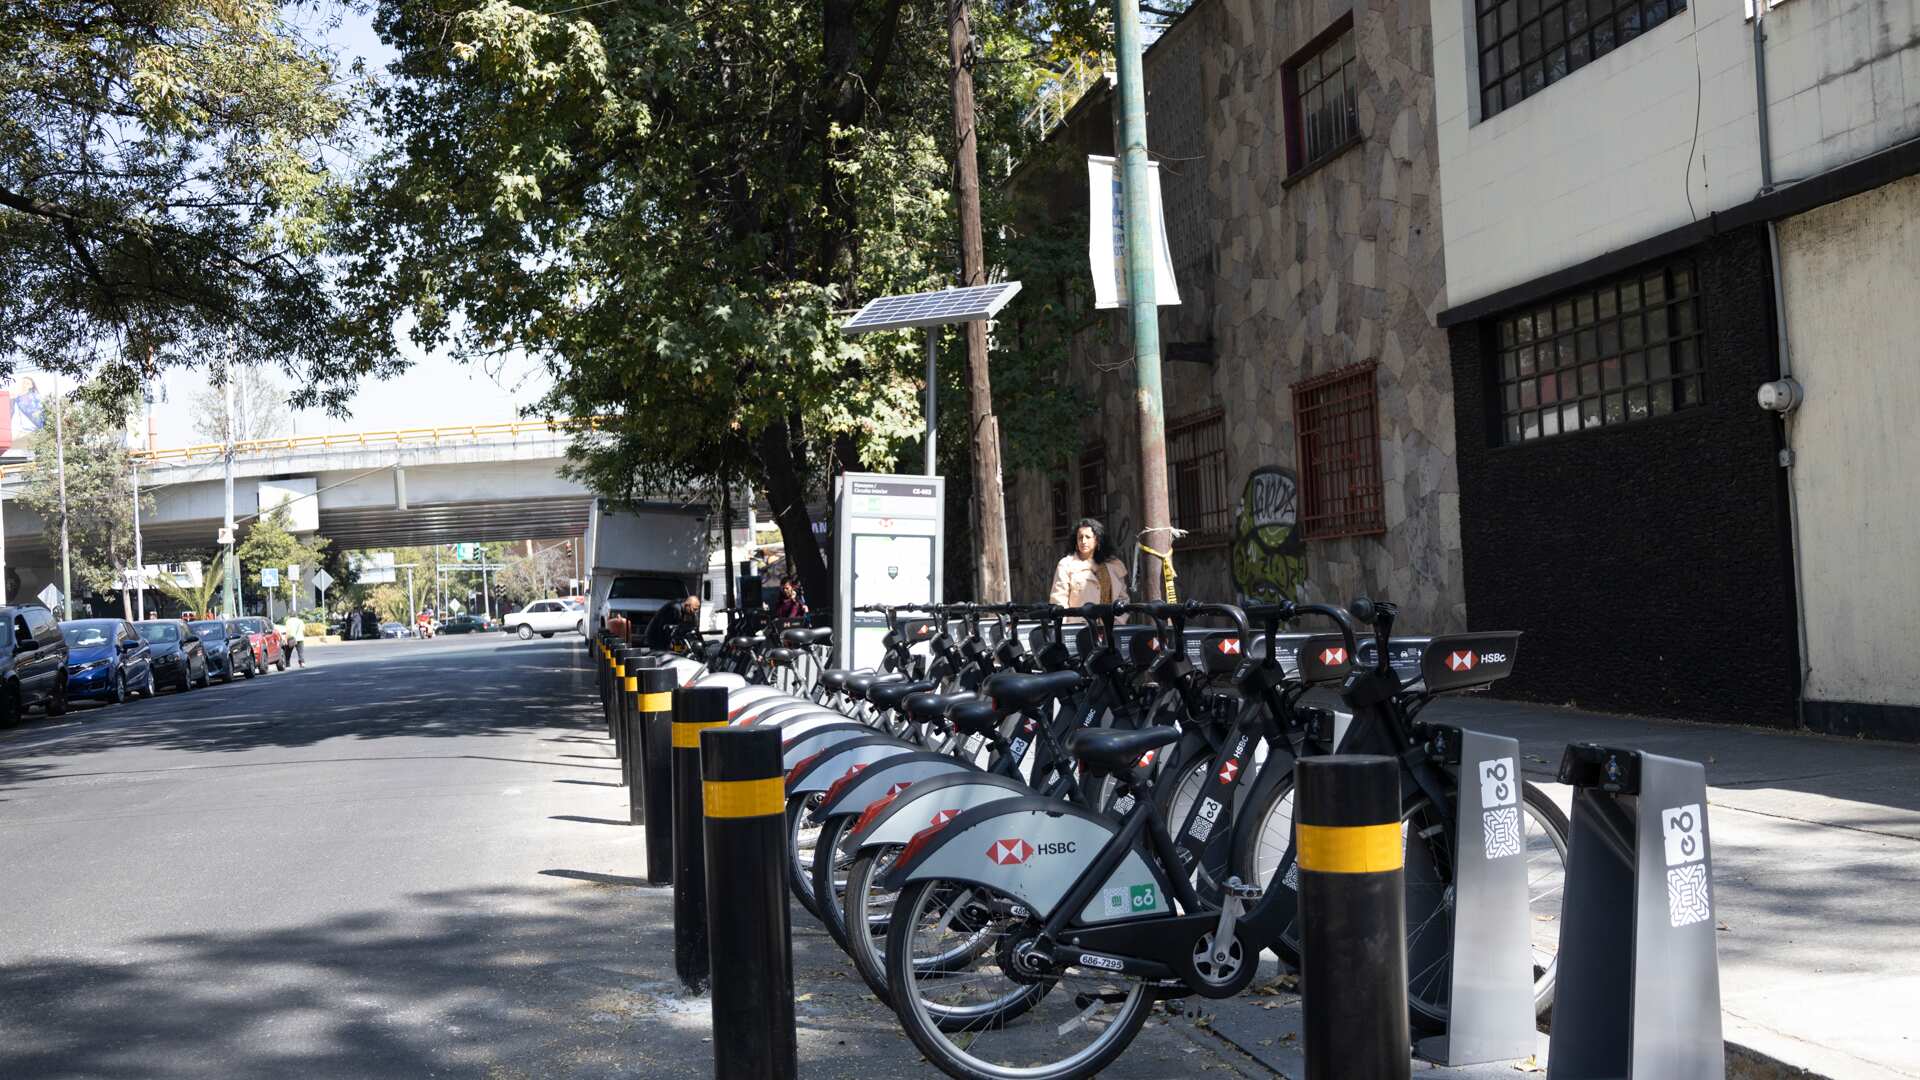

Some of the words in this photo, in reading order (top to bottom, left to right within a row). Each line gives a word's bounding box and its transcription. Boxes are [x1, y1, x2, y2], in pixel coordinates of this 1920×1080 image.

[1233, 735, 1249, 758] HSBC
[1037, 841, 1077, 856] HSBC
[1082, 955, 1122, 969] 686-7295
